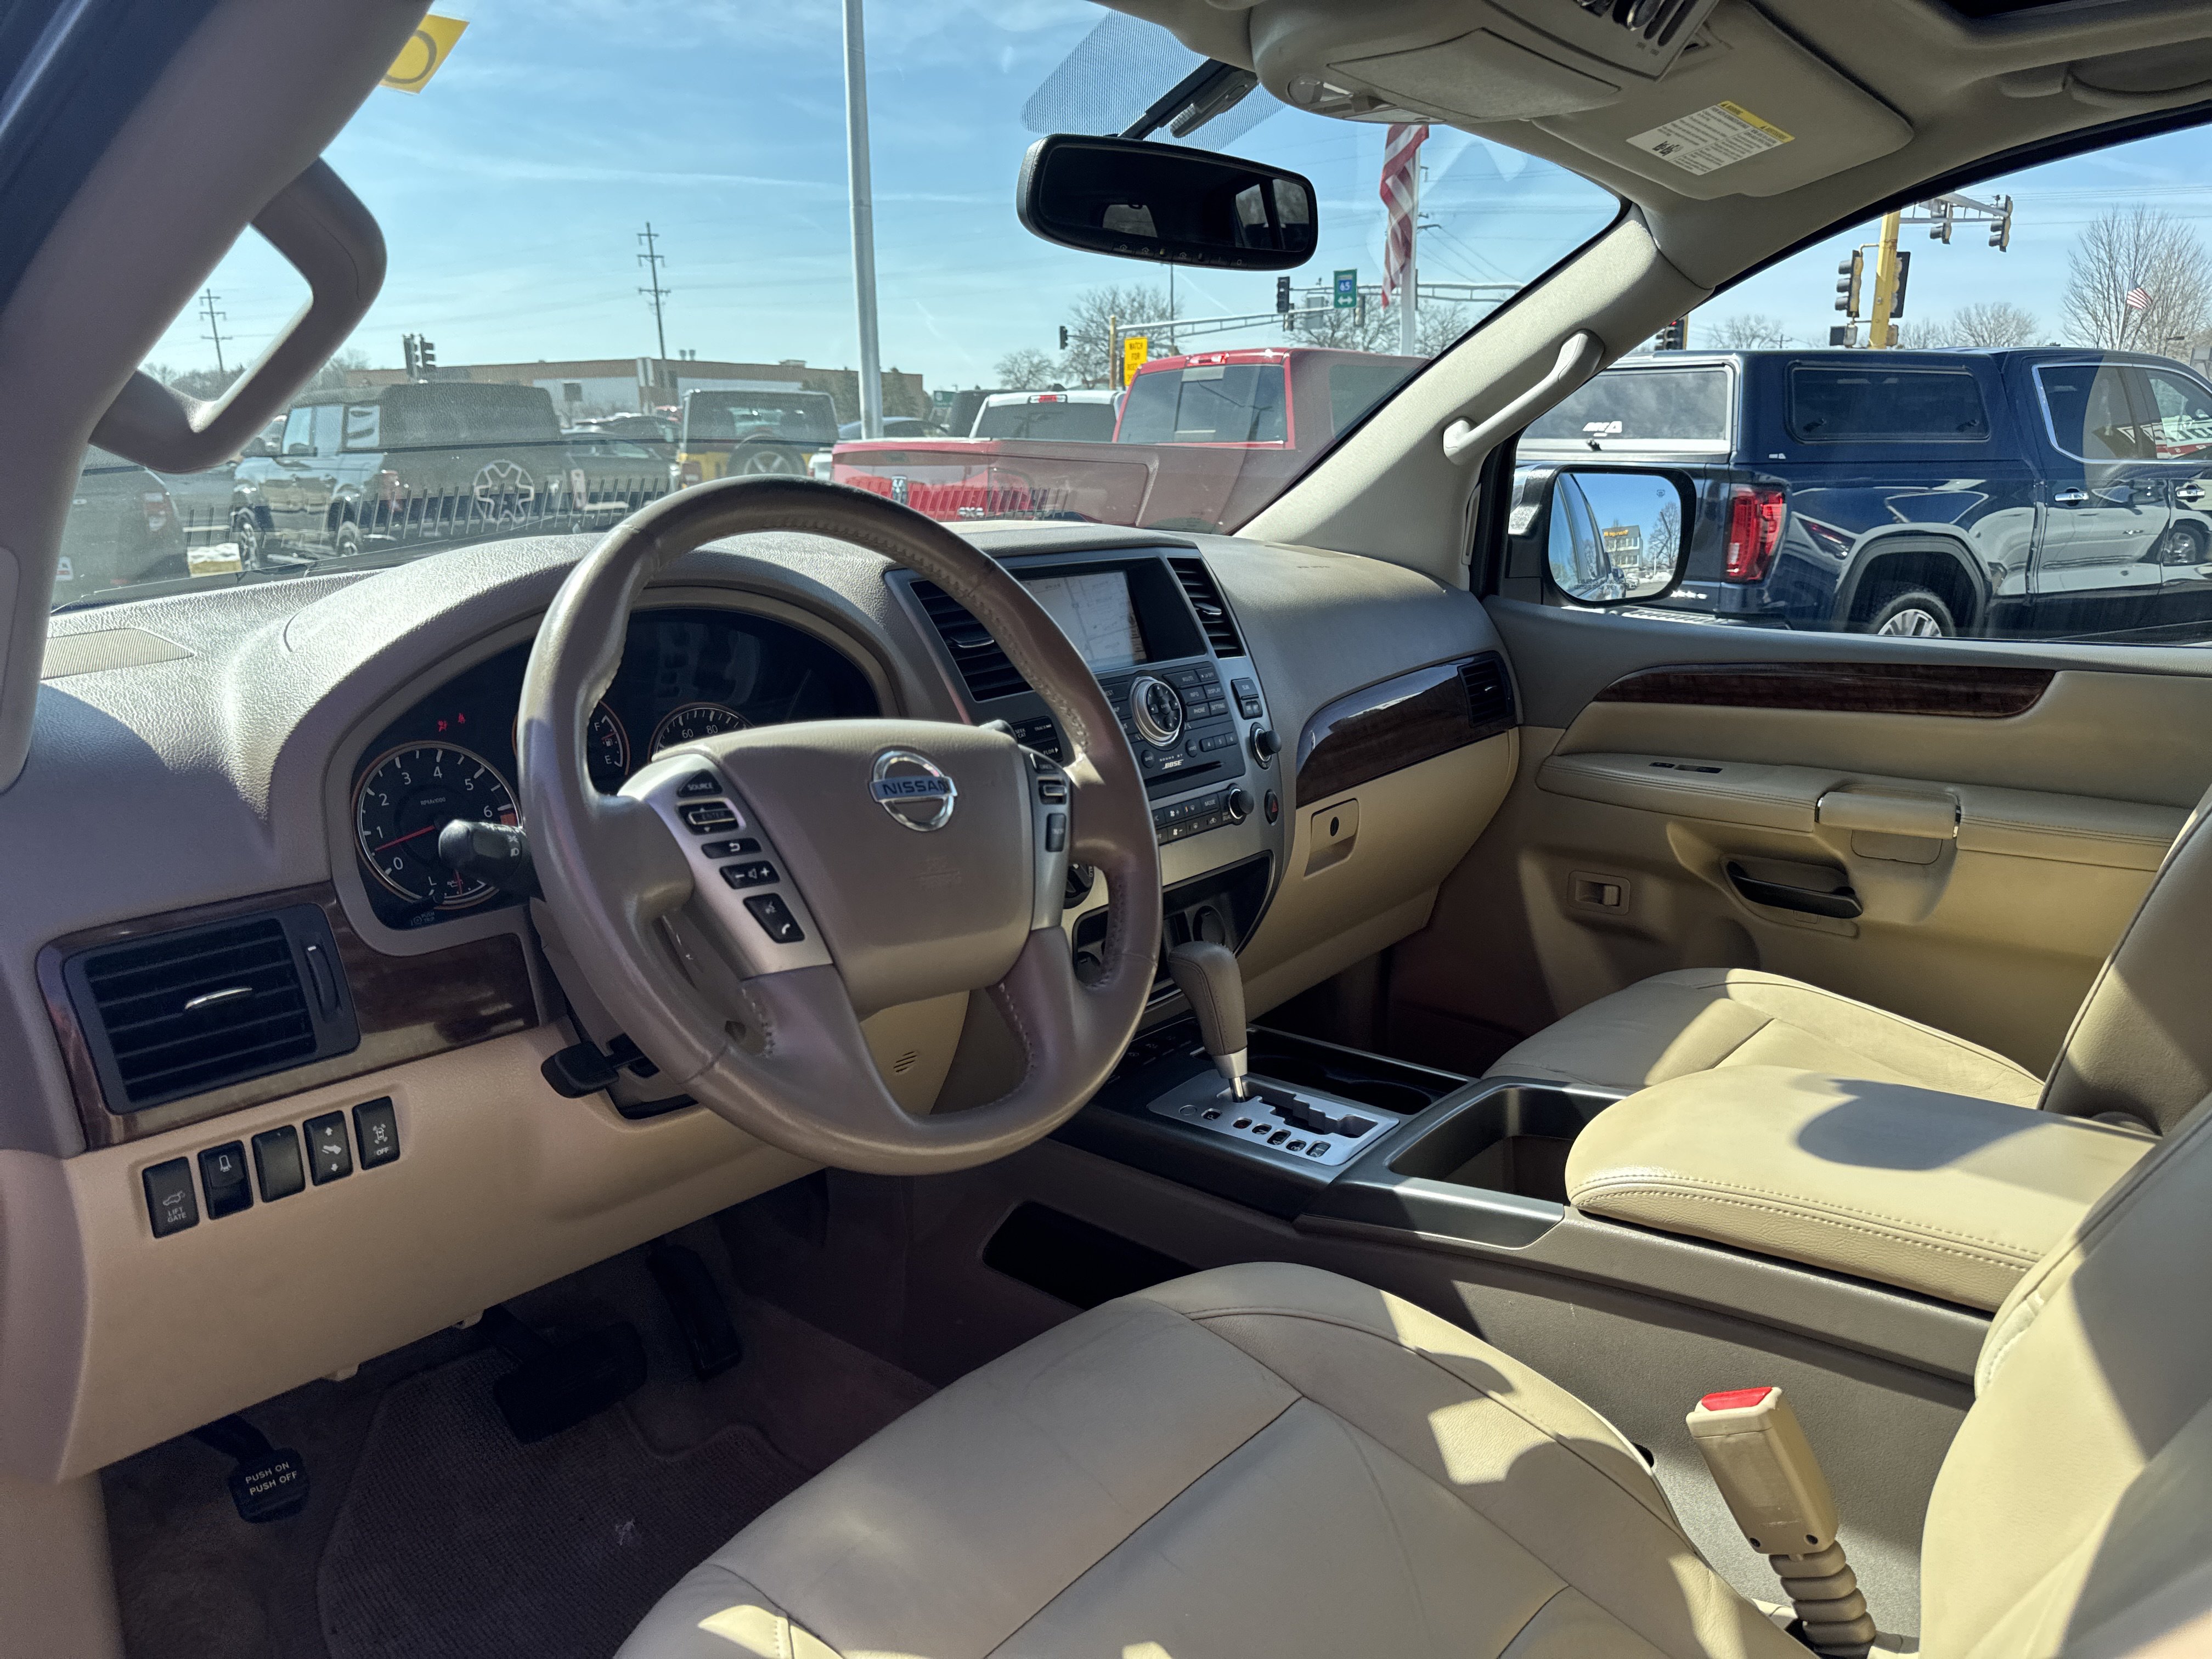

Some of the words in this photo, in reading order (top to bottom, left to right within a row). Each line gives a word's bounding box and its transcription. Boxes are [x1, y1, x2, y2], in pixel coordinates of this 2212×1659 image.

[594, 722, 600, 731] F
[706, 725, 718, 735] 80
[682, 729, 694, 738] 60
[605, 755, 612, 764] E
[1162, 759, 1184, 770] BOSE
[433, 766, 442, 778] 4
[402, 772, 411, 785] 3
[464, 778, 474, 791] 5
[687, 782, 713, 791] SOURCE
[882, 780, 951, 795] NISSAN
[379, 793, 390, 806] 2
[483, 805, 493, 817] 6
[376, 826, 383, 838] 1
[393, 857, 403, 870] 0
[428, 876, 437, 885] L
[377, 1147, 389, 1155] OFF
[167, 1207, 183, 1217] LIFT
[167, 1212, 187, 1223] GATE
[245, 1468, 272, 1485] PUSH
[274, 1461, 290, 1472] ON
[249, 1479, 276, 1496] PUSH
[279, 1470, 298, 1483] OFF
